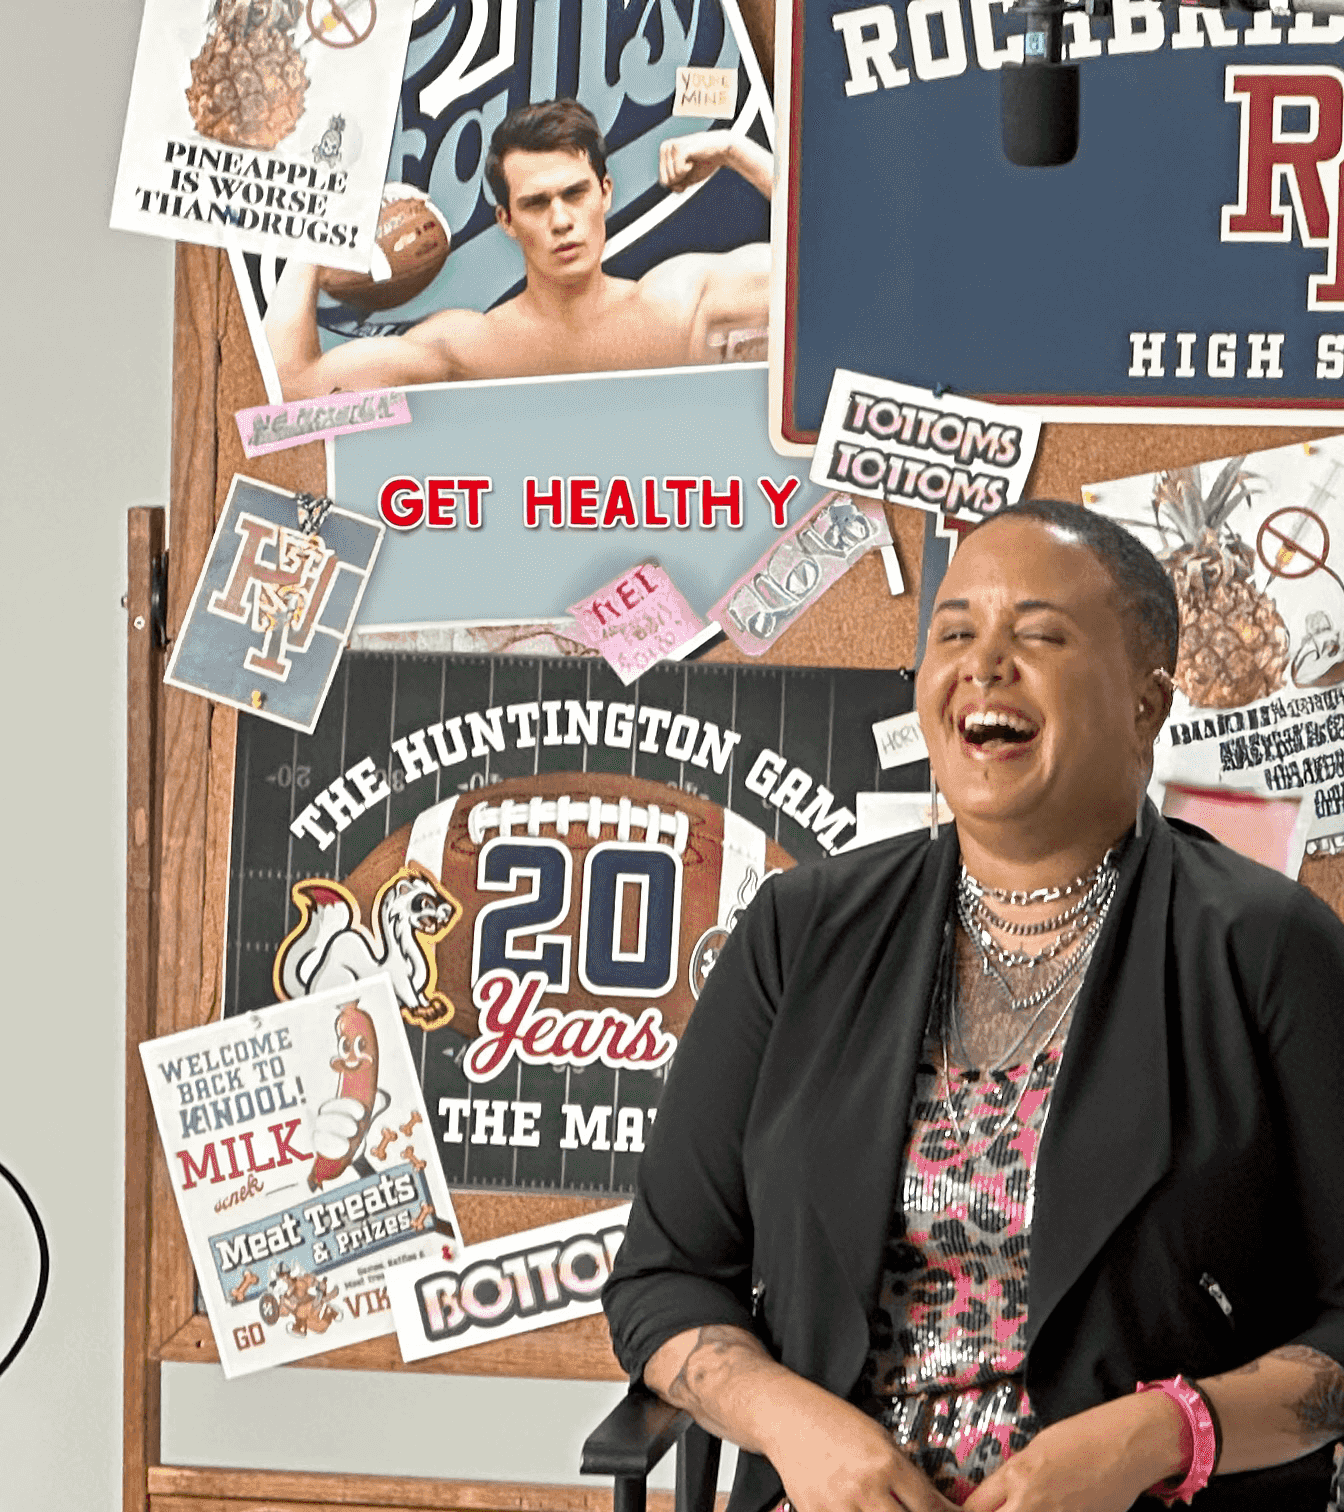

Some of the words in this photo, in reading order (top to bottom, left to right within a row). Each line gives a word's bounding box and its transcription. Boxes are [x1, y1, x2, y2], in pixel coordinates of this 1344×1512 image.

[165, 141, 348, 194] PINEAPPLE
[171, 169, 200, 194] IS
[209, 175, 329, 217] WORSE
[136, 187, 228, 226] THAN
[238, 207, 359, 248] DRUGS!
[1128, 332, 1285, 380] HIGH
[380, 477, 492, 529] GET
[290, 756, 391, 851] THE
[391, 700, 741, 784] HUNTINGTON
[471, 836, 684, 998] 20
[465, 969, 676, 1082] Years
[158, 1027, 293, 1083] WELCOME
[177, 1067, 245, 1105] BACK
[252, 1056, 286, 1083] TO
[438, 1098, 542, 1147] THE
[560, 1104, 657, 1153] MA
[175, 1118, 315, 1190] MILK
[215, 1213, 304, 1272] Meat
[304, 1173, 418, 1237] Treats
[336, 1210, 412, 1255] Prizes
[233, 1322, 266, 1351] GO
